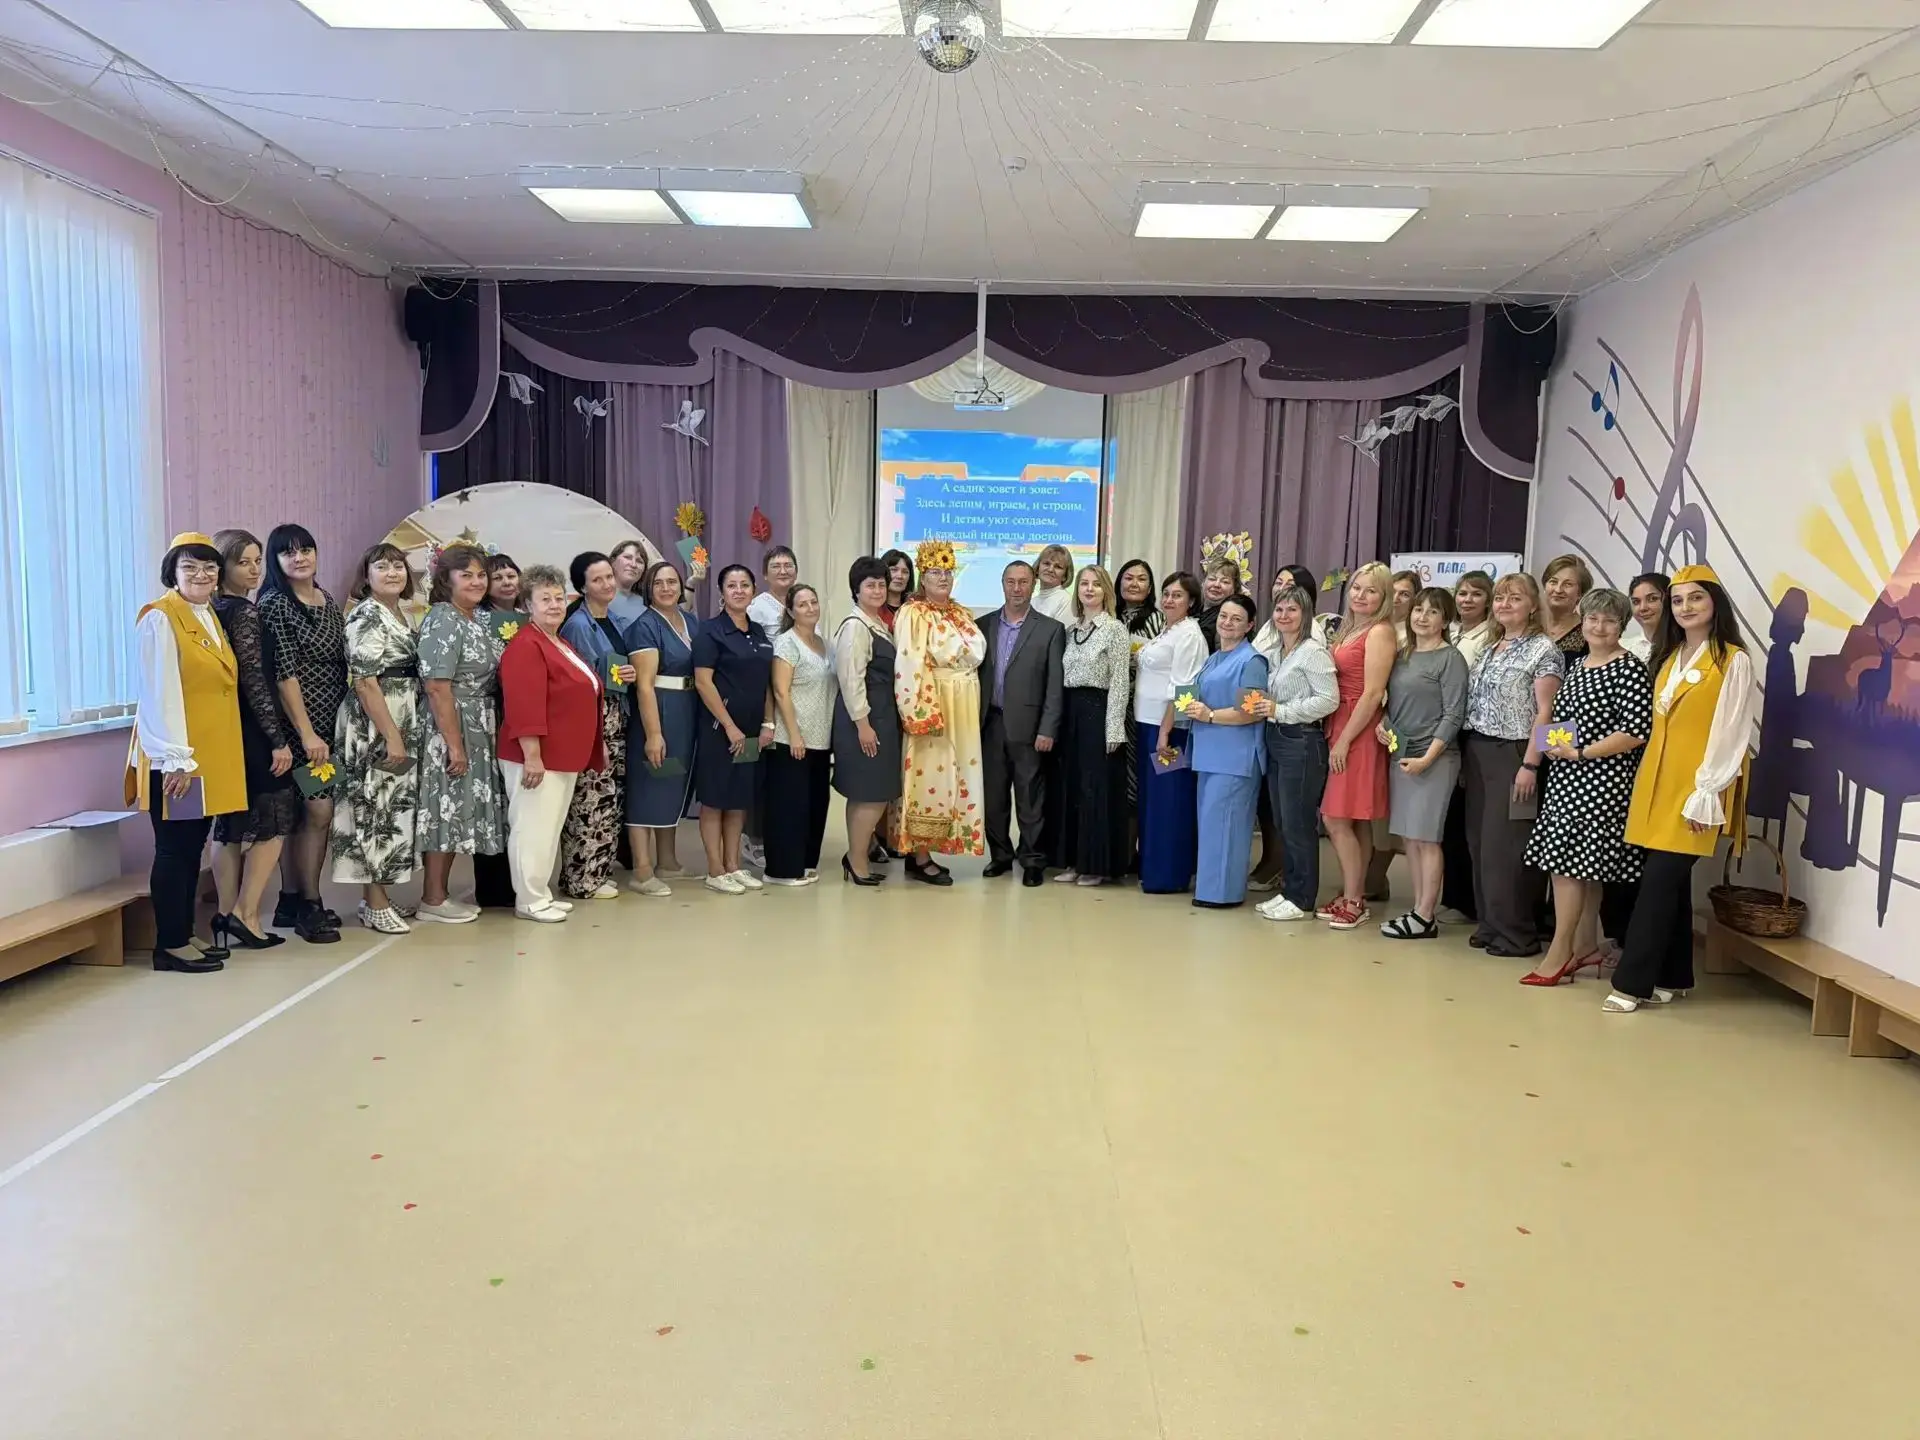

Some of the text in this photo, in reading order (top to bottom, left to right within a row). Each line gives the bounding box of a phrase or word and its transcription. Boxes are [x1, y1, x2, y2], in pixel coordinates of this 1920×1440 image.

[952, 485, 985, 494] садик
[987, 486, 1016, 494] зовет
[915, 497, 945, 508] Здесь
[948, 499, 985, 511] лепим,
[988, 501, 1030, 512] играем,
[1032, 502, 1040, 510] и
[941, 512, 951, 524] И
[954, 515, 985, 525] детям
[987, 516, 1009, 527] уют
[923, 527, 932, 539] И
[980, 531, 1025, 542] награды
[1437, 561, 1466, 574] ПАПА
